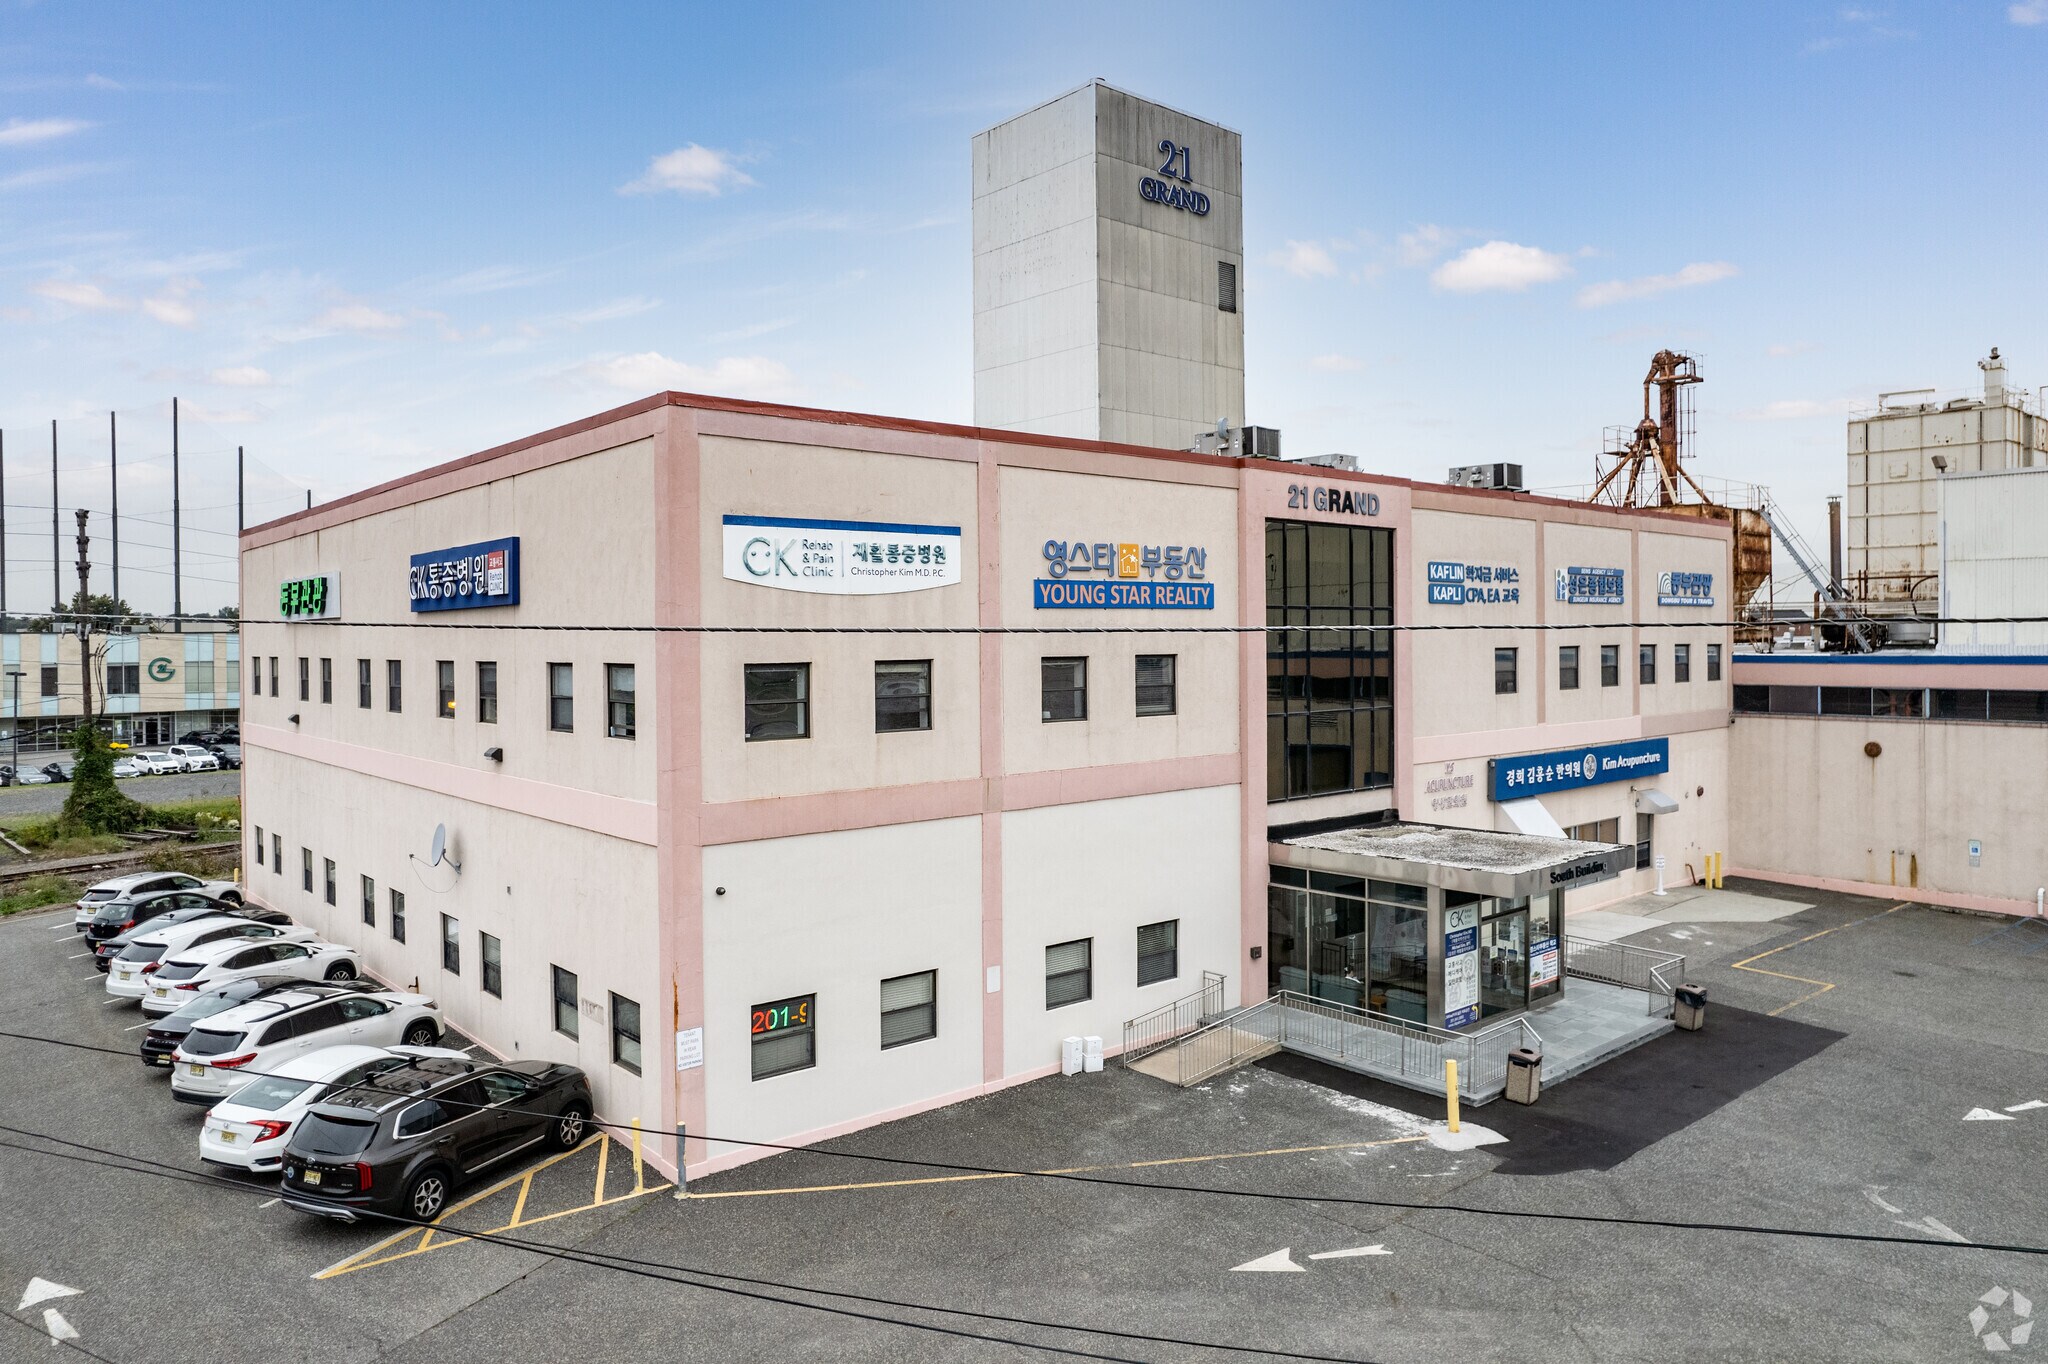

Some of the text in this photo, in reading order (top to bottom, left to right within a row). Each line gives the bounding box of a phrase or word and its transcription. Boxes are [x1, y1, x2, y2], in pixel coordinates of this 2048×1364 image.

[1157, 139, 1193, 184] 21
[1139, 177, 1211, 216] GRAND
[1288, 484, 1380, 516] 21 GRAND
[742, 536, 798, 577] CK
[802, 539, 834, 551] Rehab
[802, 552, 834, 564] & Pain
[1042, 539, 1207, 580] 영스타 부동산
[802, 566, 834, 577] Clinic
[850, 566, 946, 578] Christopher Kim M.D. P.C.
[1465, 565, 1492, 583] 학자금
[1493, 567, 1519, 584] 서비스
[280, 577, 327, 617] 동부관광
[1039, 583, 1211, 605] YOUNG STAR REALTY
[1487, 588, 1500, 603] EA
[1502, 588, 1520, 604] 교육
[1506, 752, 1661, 787] 경희 김홍순 한의원 Kim Acupuncture
[1550, 861, 1607, 884] South Building
